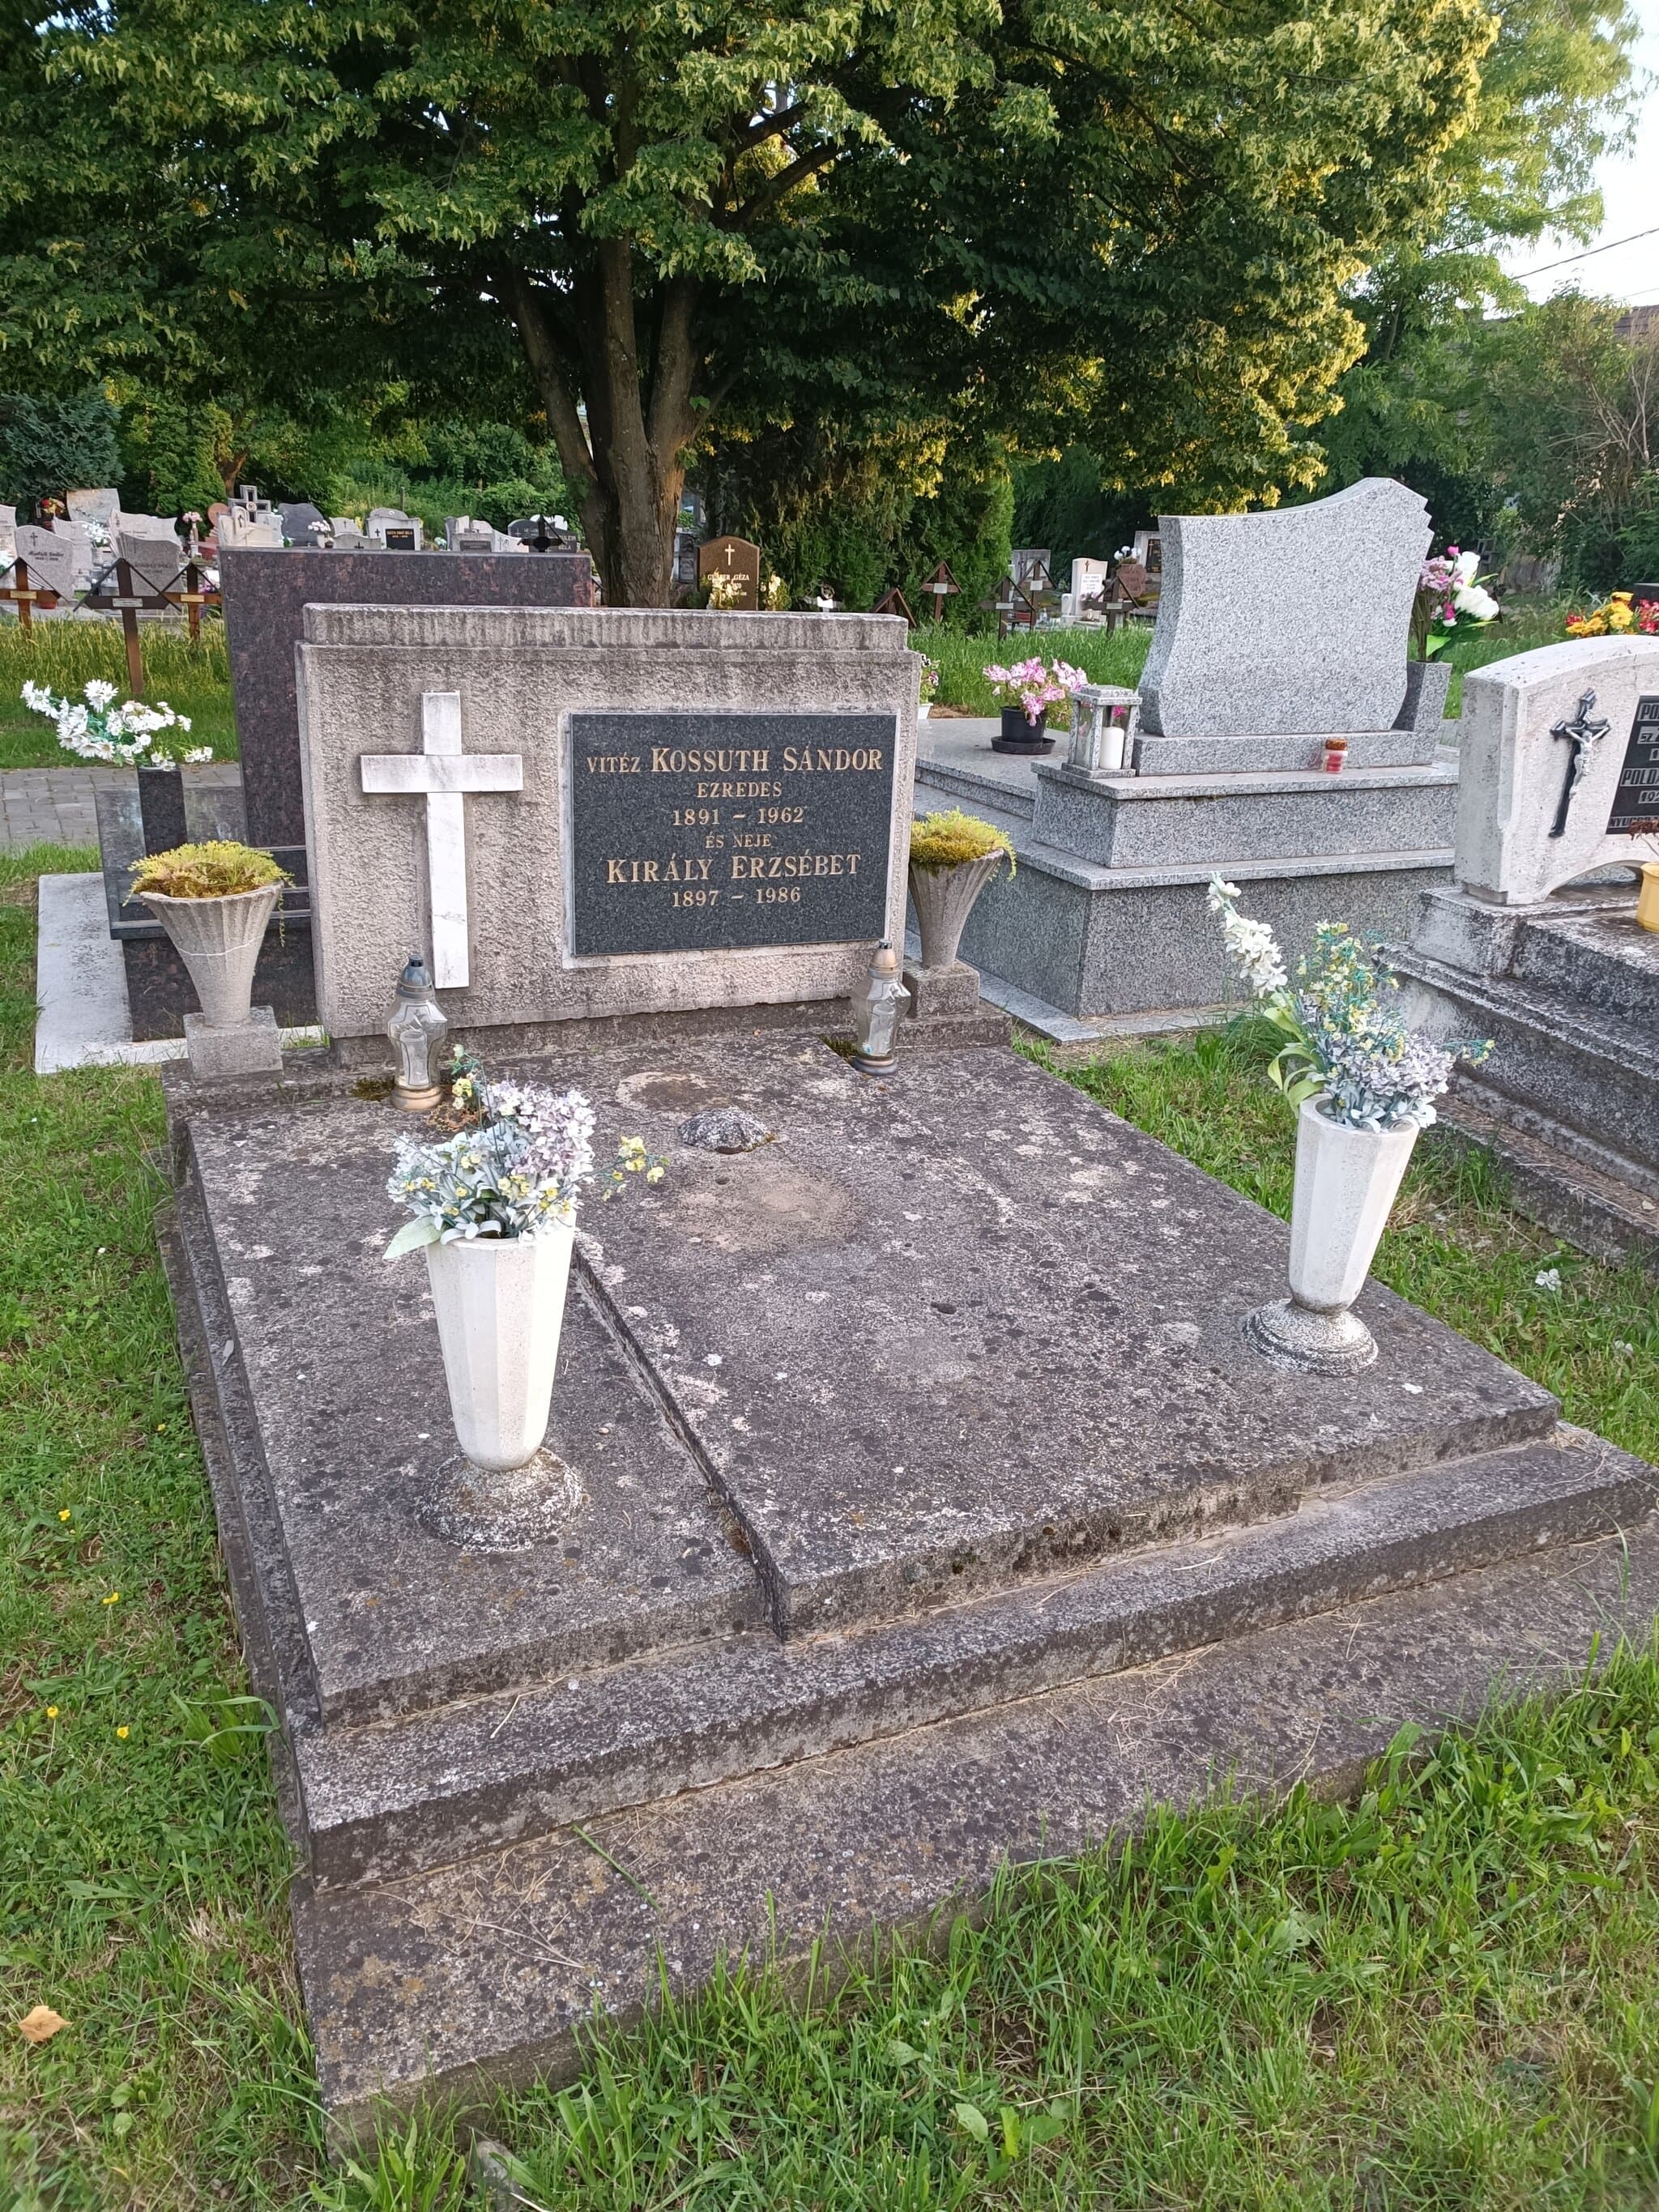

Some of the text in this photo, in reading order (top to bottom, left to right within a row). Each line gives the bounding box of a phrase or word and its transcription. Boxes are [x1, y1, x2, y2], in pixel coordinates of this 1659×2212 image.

[586, 742, 883, 773] VITÉZ KOSSUTH SÁNDOR
[697, 782, 783, 798] EZREDES
[672, 808, 720, 825] 1891
[757, 806, 804, 824] 1962
[705, 831, 725, 849] ÉS
[606, 848, 862, 884] KIRÁLY ERZSÉBET
[672, 890, 719, 907] 1897
[756, 886, 801, 904] 1986
